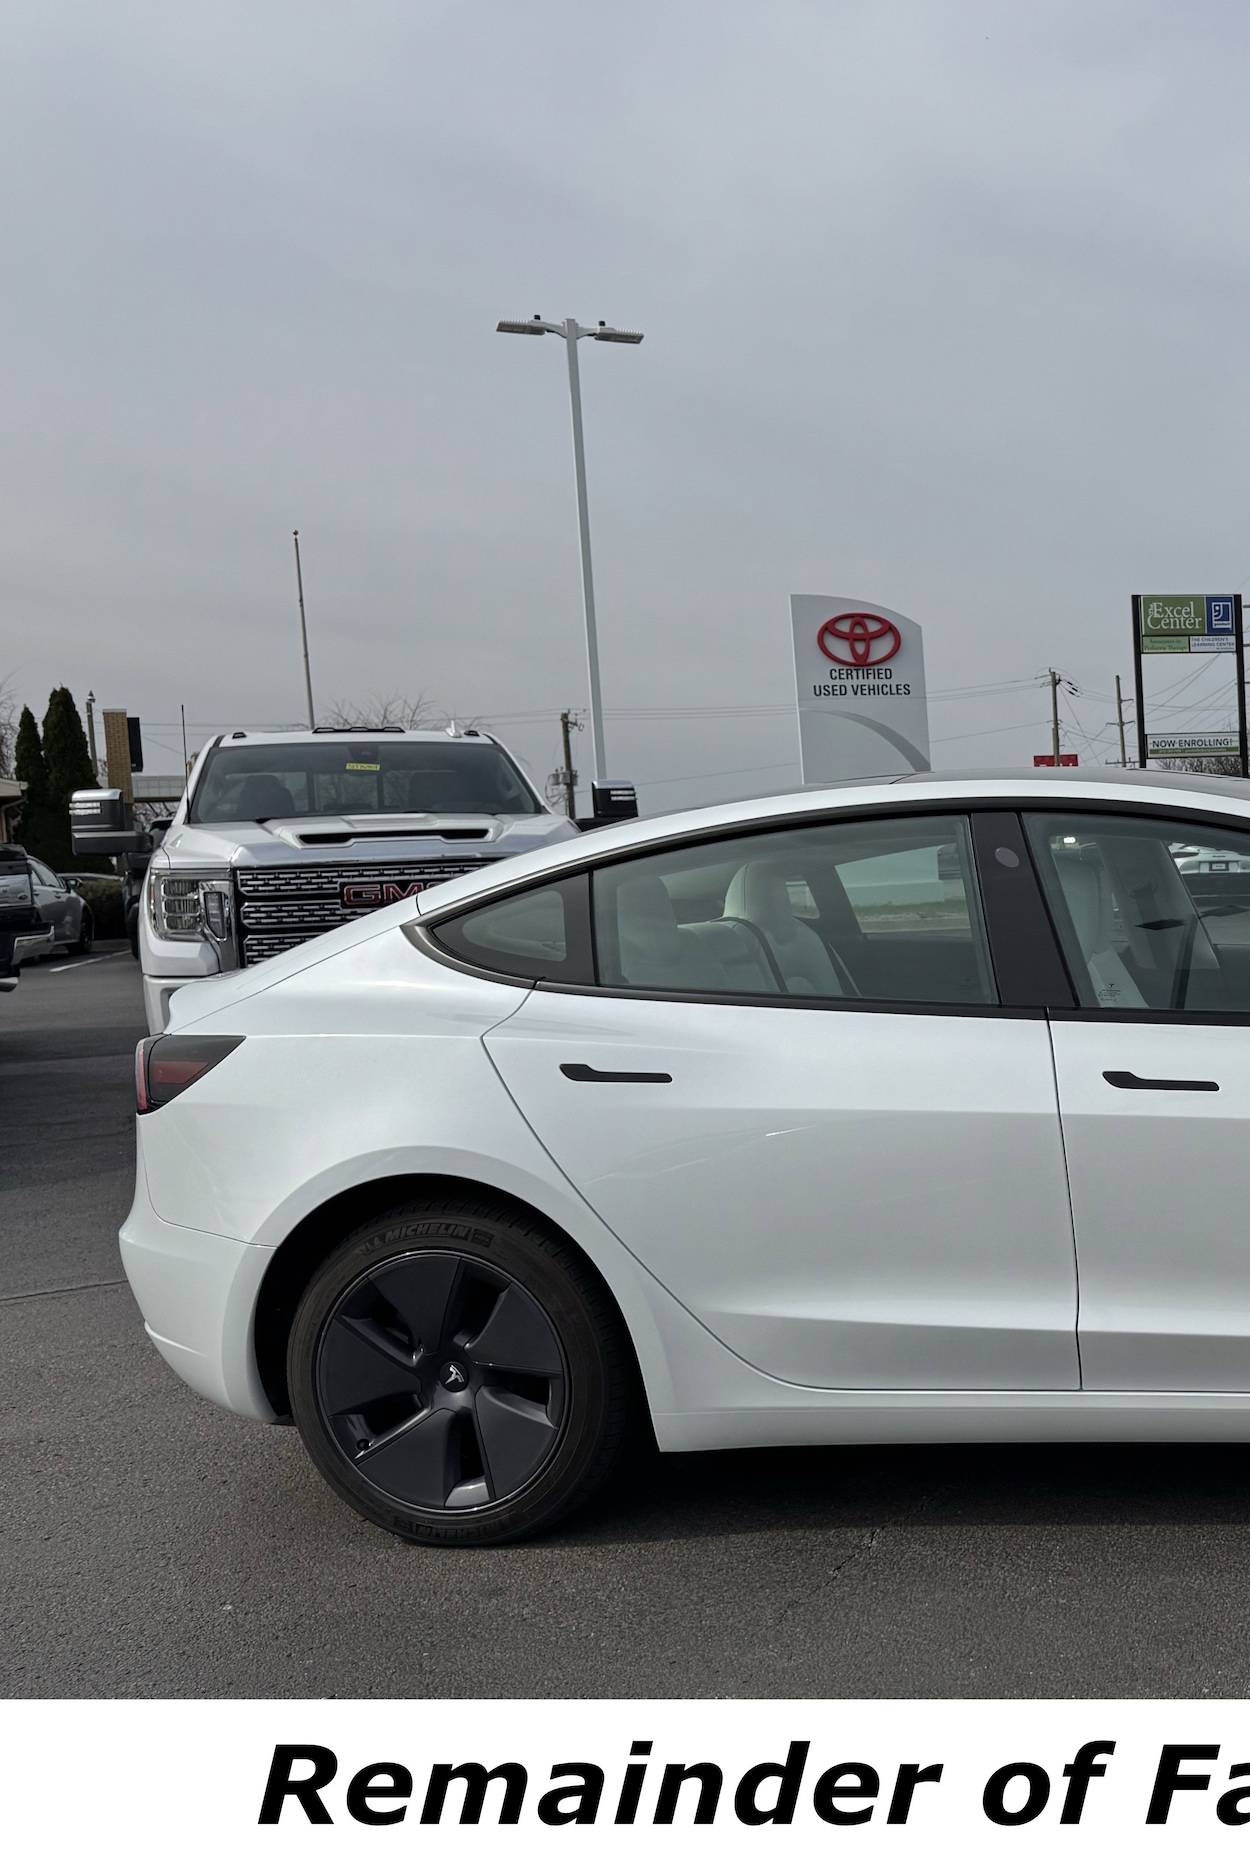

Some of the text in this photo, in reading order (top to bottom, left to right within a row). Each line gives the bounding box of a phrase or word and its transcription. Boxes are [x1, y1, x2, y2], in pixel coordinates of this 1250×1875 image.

[1153, 601, 1195, 618] Excel
[1147, 615, 1202, 630] Center
[829, 668, 893, 680] CERTIFIED
[813, 683, 911, 697] USED VEHICLES
[1152, 738, 1233, 748] NOW ENROLLING!
[384, 1223, 471, 1243] MICHELIN
